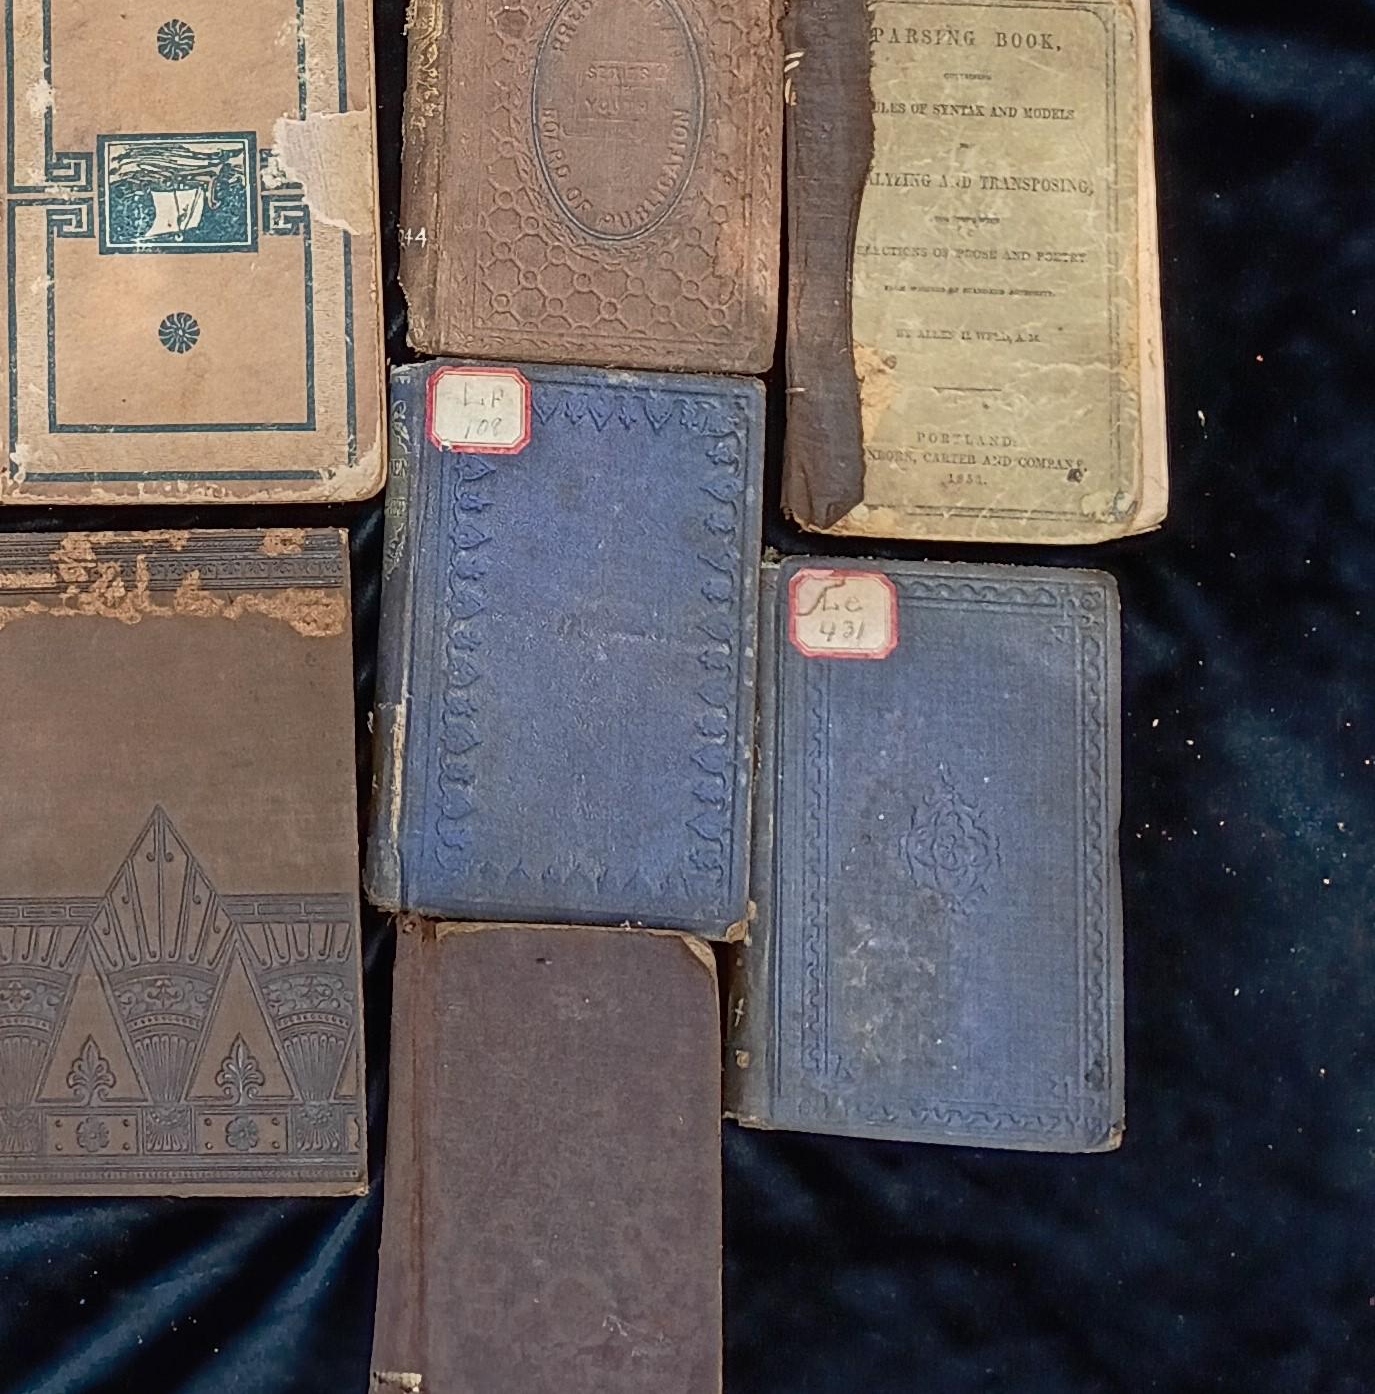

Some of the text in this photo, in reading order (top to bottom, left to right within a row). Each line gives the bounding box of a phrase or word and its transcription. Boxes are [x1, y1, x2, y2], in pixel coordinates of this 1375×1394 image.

[871, 27, 1062, 52] PARSING BOOK,
[911, 103, 927, 115] OF
[933, 104, 985, 117] SYNTAX
[990, 106, 1018, 118] AND
[1024, 107, 1074, 120] MODELS
[982, 455, 1012, 467] AND
